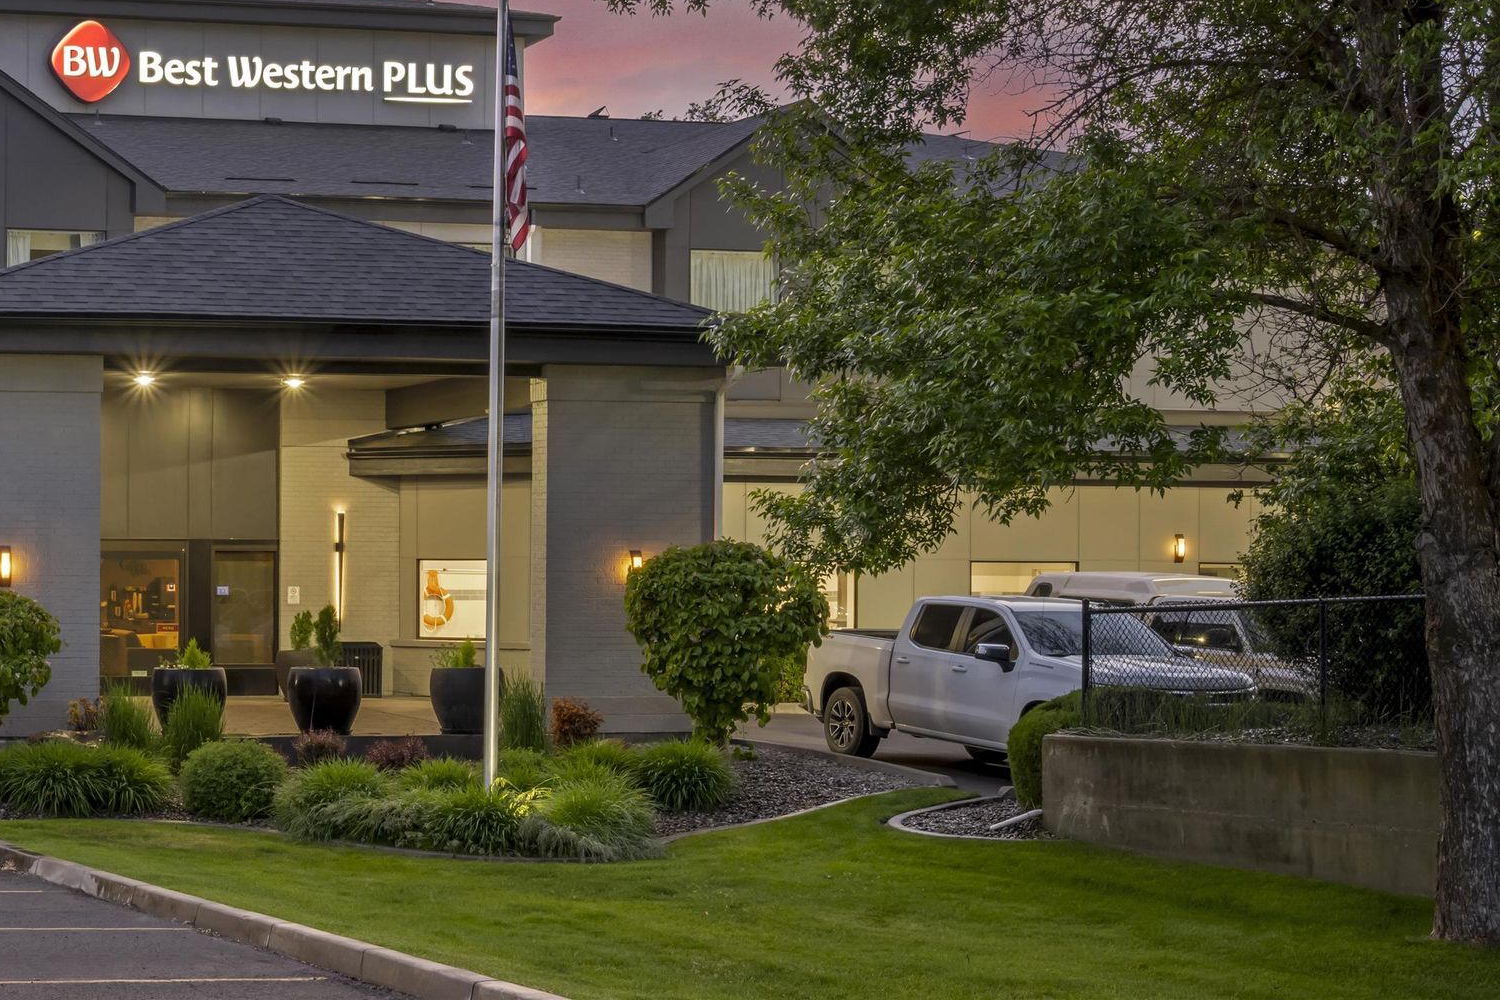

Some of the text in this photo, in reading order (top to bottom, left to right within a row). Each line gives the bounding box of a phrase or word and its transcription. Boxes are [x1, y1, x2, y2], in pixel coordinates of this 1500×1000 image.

[62, 45, 121, 78] BW
[138, 50, 475, 97] Best Western PLUS
